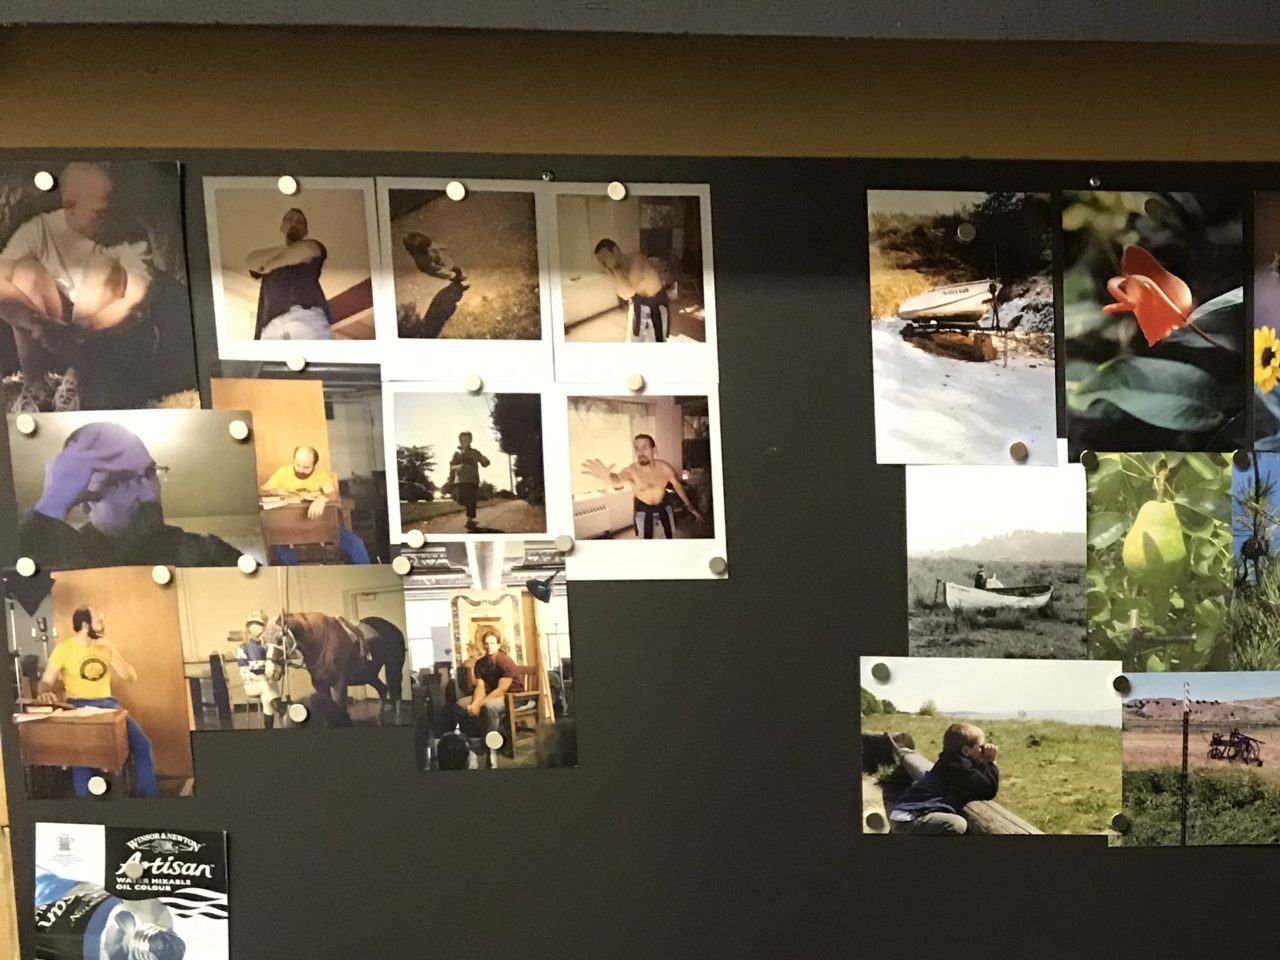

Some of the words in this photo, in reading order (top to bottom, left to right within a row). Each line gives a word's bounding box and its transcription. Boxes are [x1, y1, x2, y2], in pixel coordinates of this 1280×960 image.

[126, 832, 160, 850] WINSOR
[160, 832, 167, 840] &
[166, 832, 202, 853] NEWTON
[115, 851, 213, 878] Artisan
[116, 883, 132, 891] OIL
[134, 884, 172, 892] COLOUR
[151, 878, 191, 886] MIXABLE
